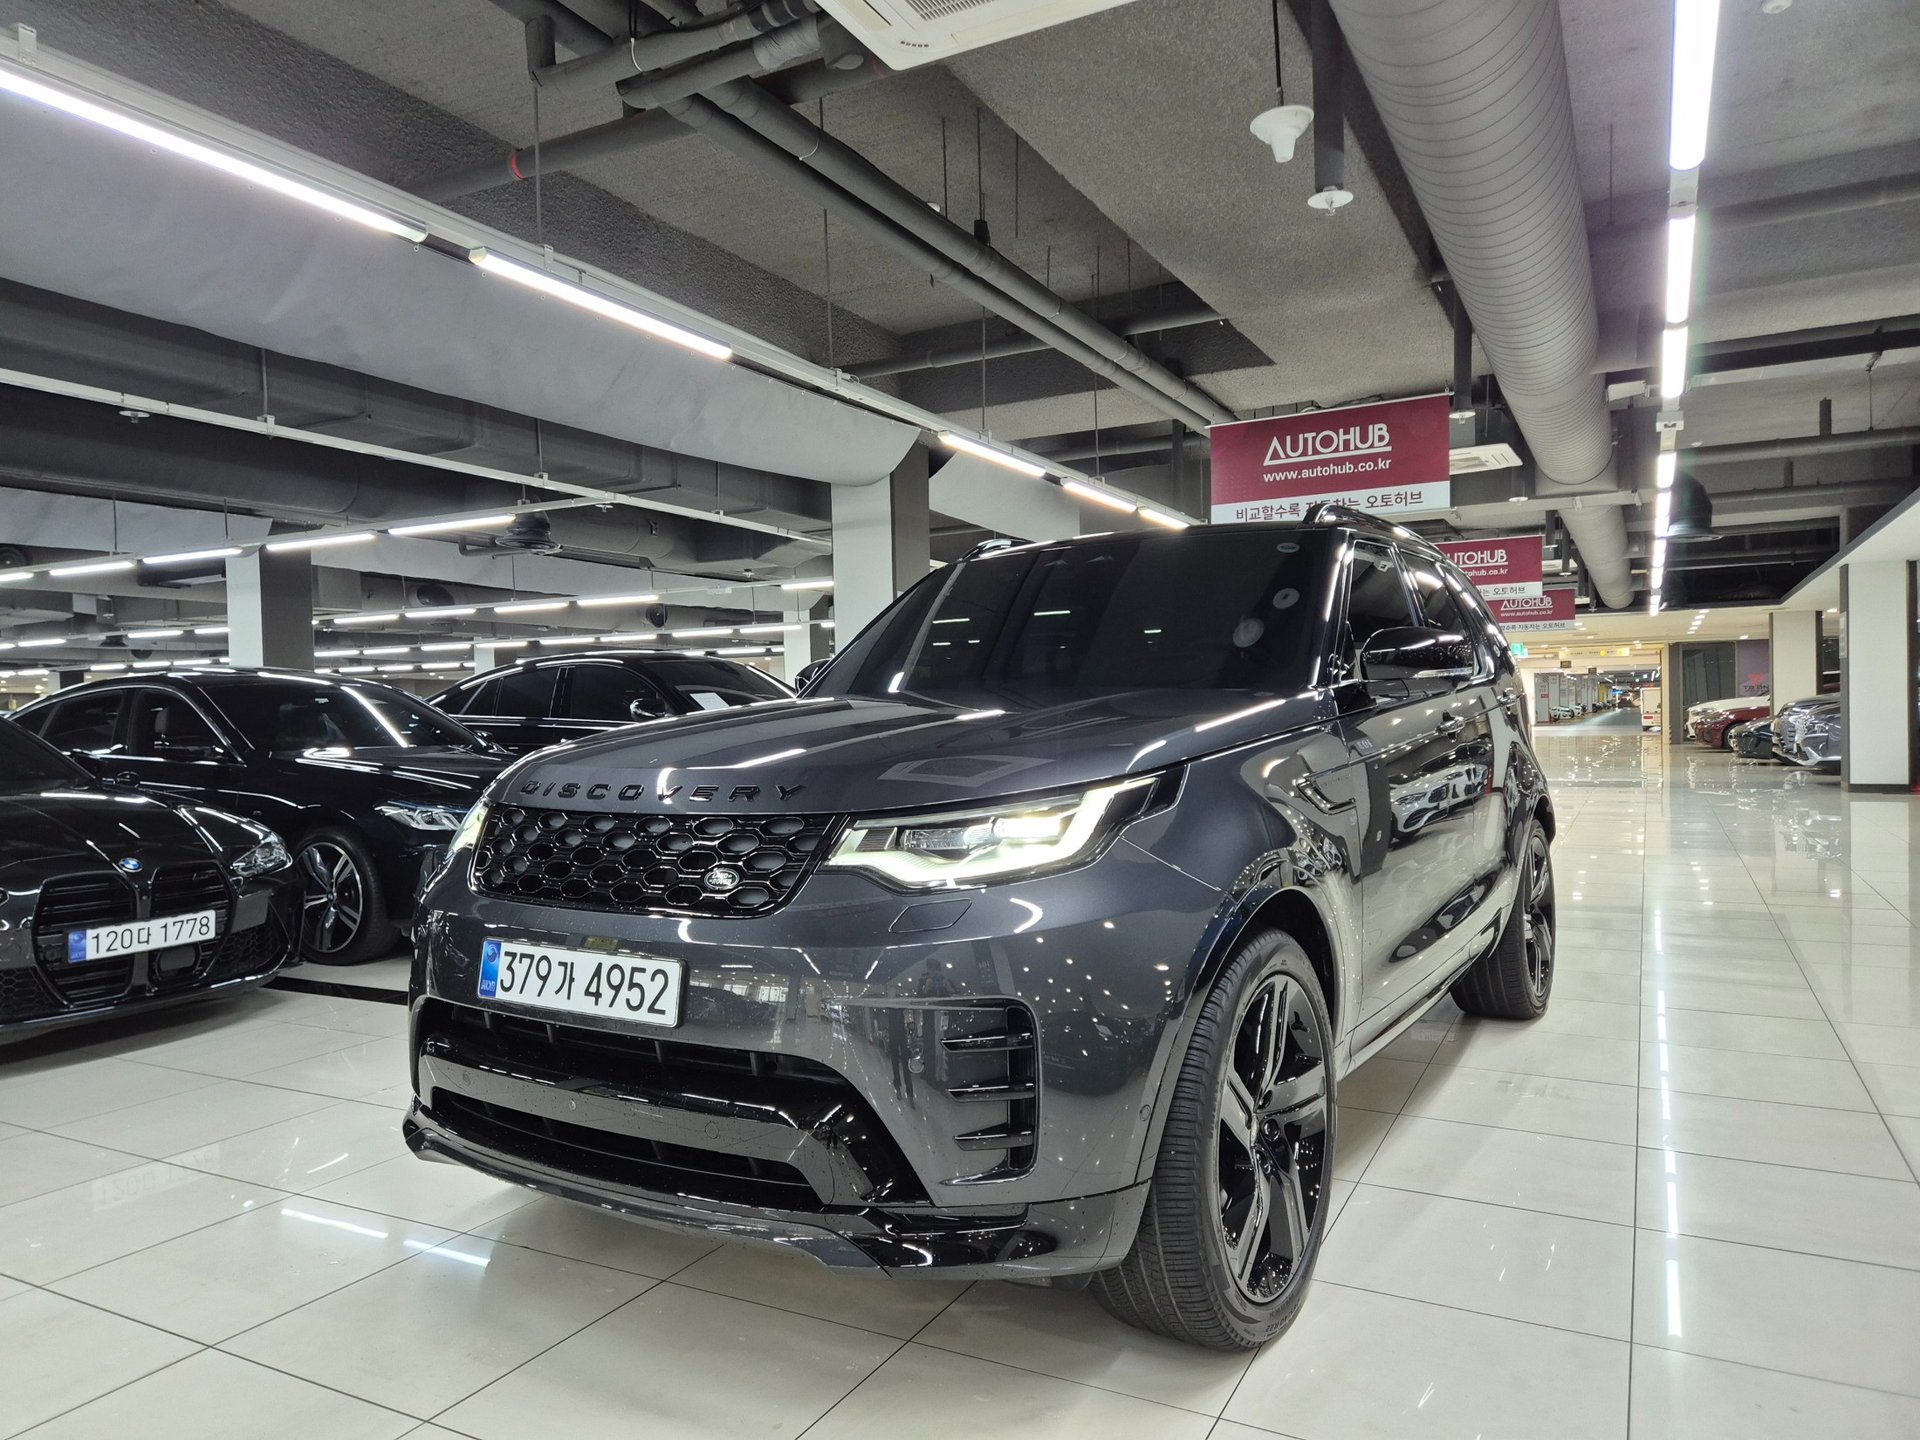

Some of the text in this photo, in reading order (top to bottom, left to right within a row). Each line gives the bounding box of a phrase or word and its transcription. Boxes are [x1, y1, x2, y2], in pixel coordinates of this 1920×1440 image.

[1262, 422, 1392, 466] AUTOHUB
[1263, 458, 1392, 482] www.autohub.co.kr
[1236, 502, 1301, 522] 비교할수록
[1364, 490, 1424, 509] 오토허브
[1447, 549, 1508, 567] UTOHUB
[1493, 586, 1526, 595] 오토허브
[1500, 597, 1553, 610] AUTOHUB
[520, 779, 804, 802] DISCOVERY
[91, 915, 210, 954] 120다 1778
[500, 951, 669, 1016] 379가 4952
